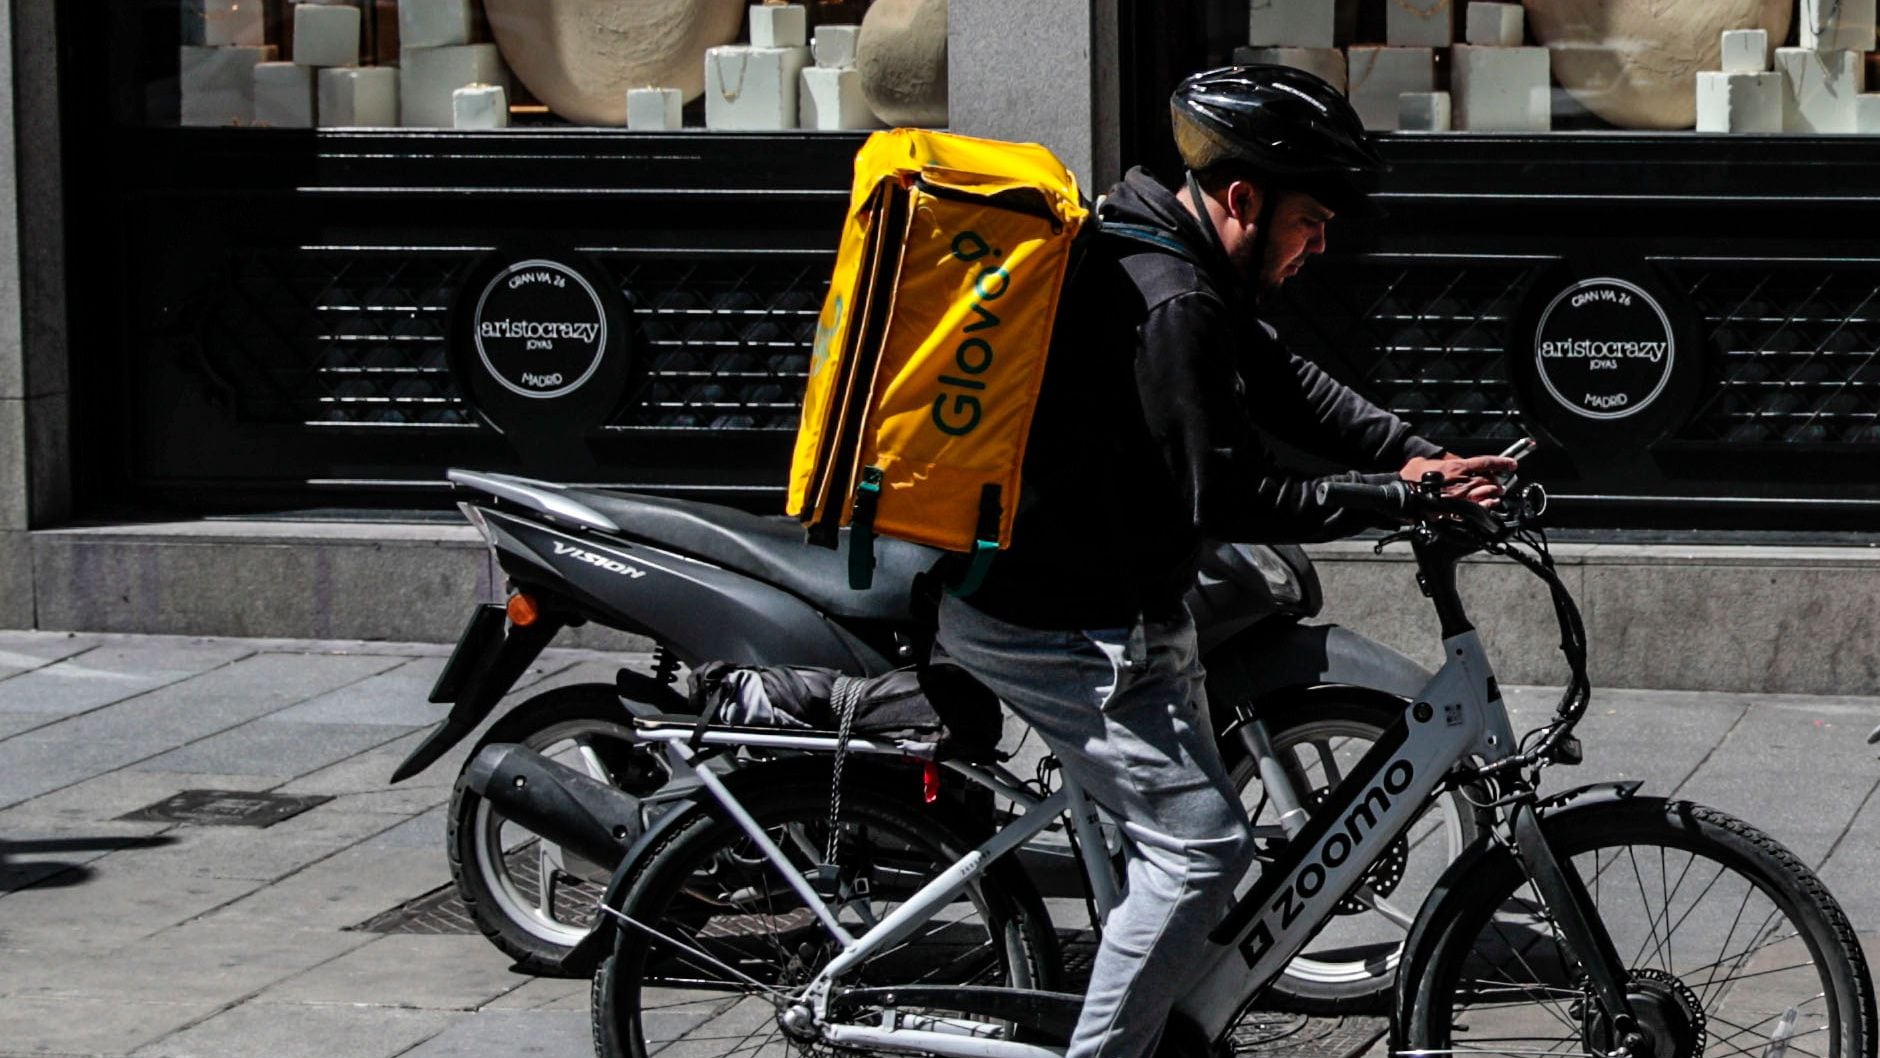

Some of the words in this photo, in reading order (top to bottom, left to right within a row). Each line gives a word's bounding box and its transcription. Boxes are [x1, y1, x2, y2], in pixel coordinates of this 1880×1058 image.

[1618, 292, 1632, 306] 26
[481, 318, 599, 344] aristocrazy
[526, 339, 553, 351] JOYAS
[932, 265, 1010, 437] Glovo
[1542, 338, 1667, 363] aristocrazy
[1589, 359, 1618, 371] JOYAS
[521, 372, 563, 388] MADRID
[1584, 393, 1628, 409] MADRID
[553, 540, 647, 579] VISION
[1271, 759, 1414, 931] zoomo
